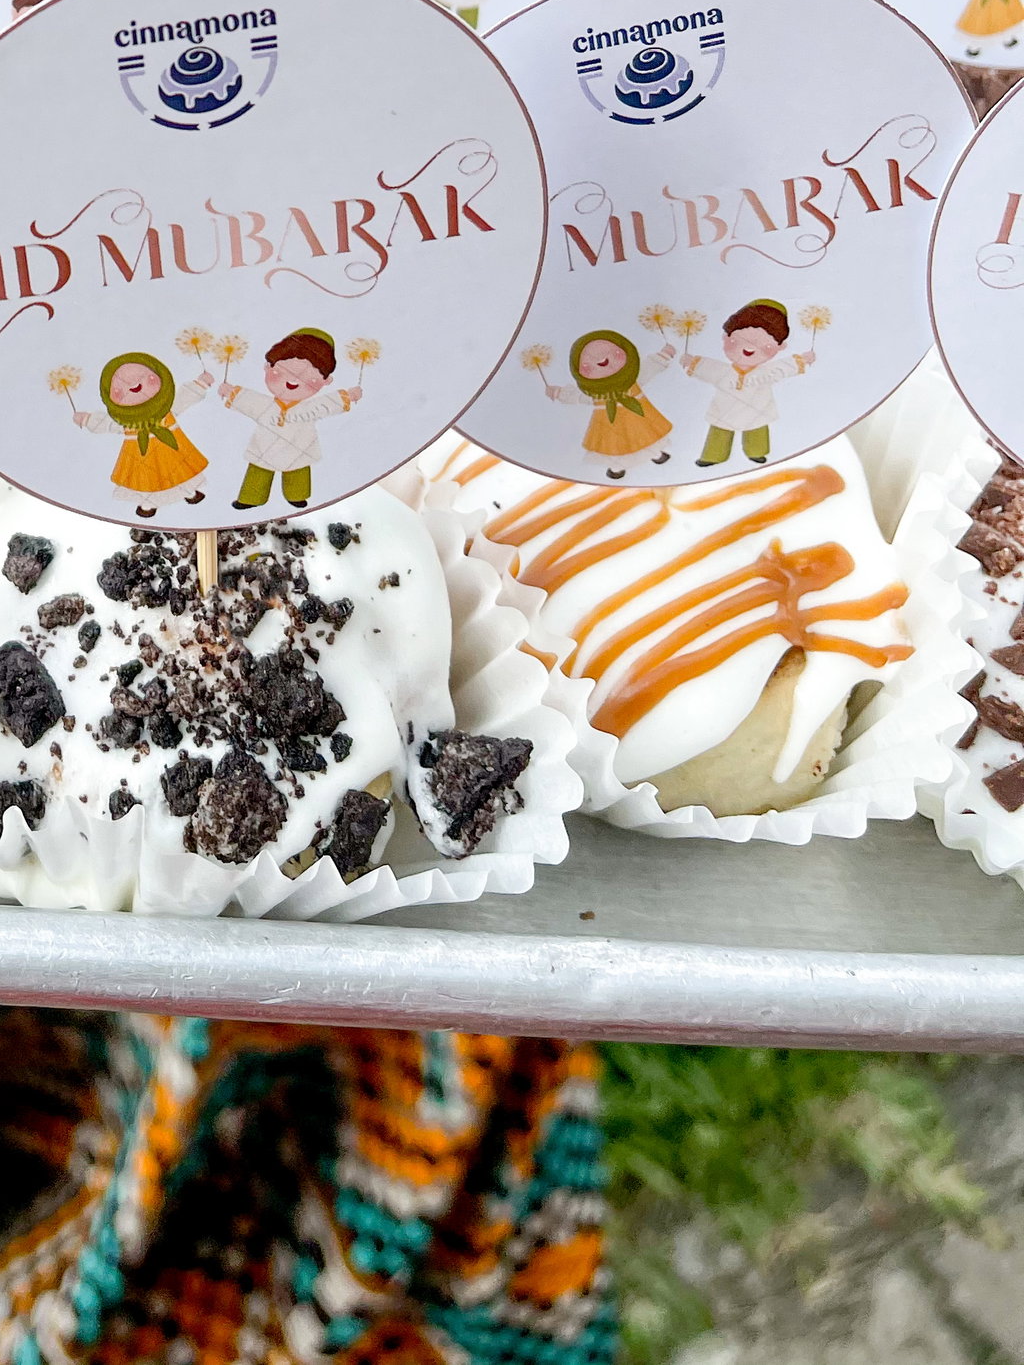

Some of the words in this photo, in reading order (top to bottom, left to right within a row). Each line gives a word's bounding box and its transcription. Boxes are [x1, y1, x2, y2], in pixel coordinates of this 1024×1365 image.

[113, 6, 278, 45] cinnamona
[571, 7, 725, 55] cinnamona
[97, 137, 499, 298] MUBARAK
[562, 113, 938, 272] MUBARAK
